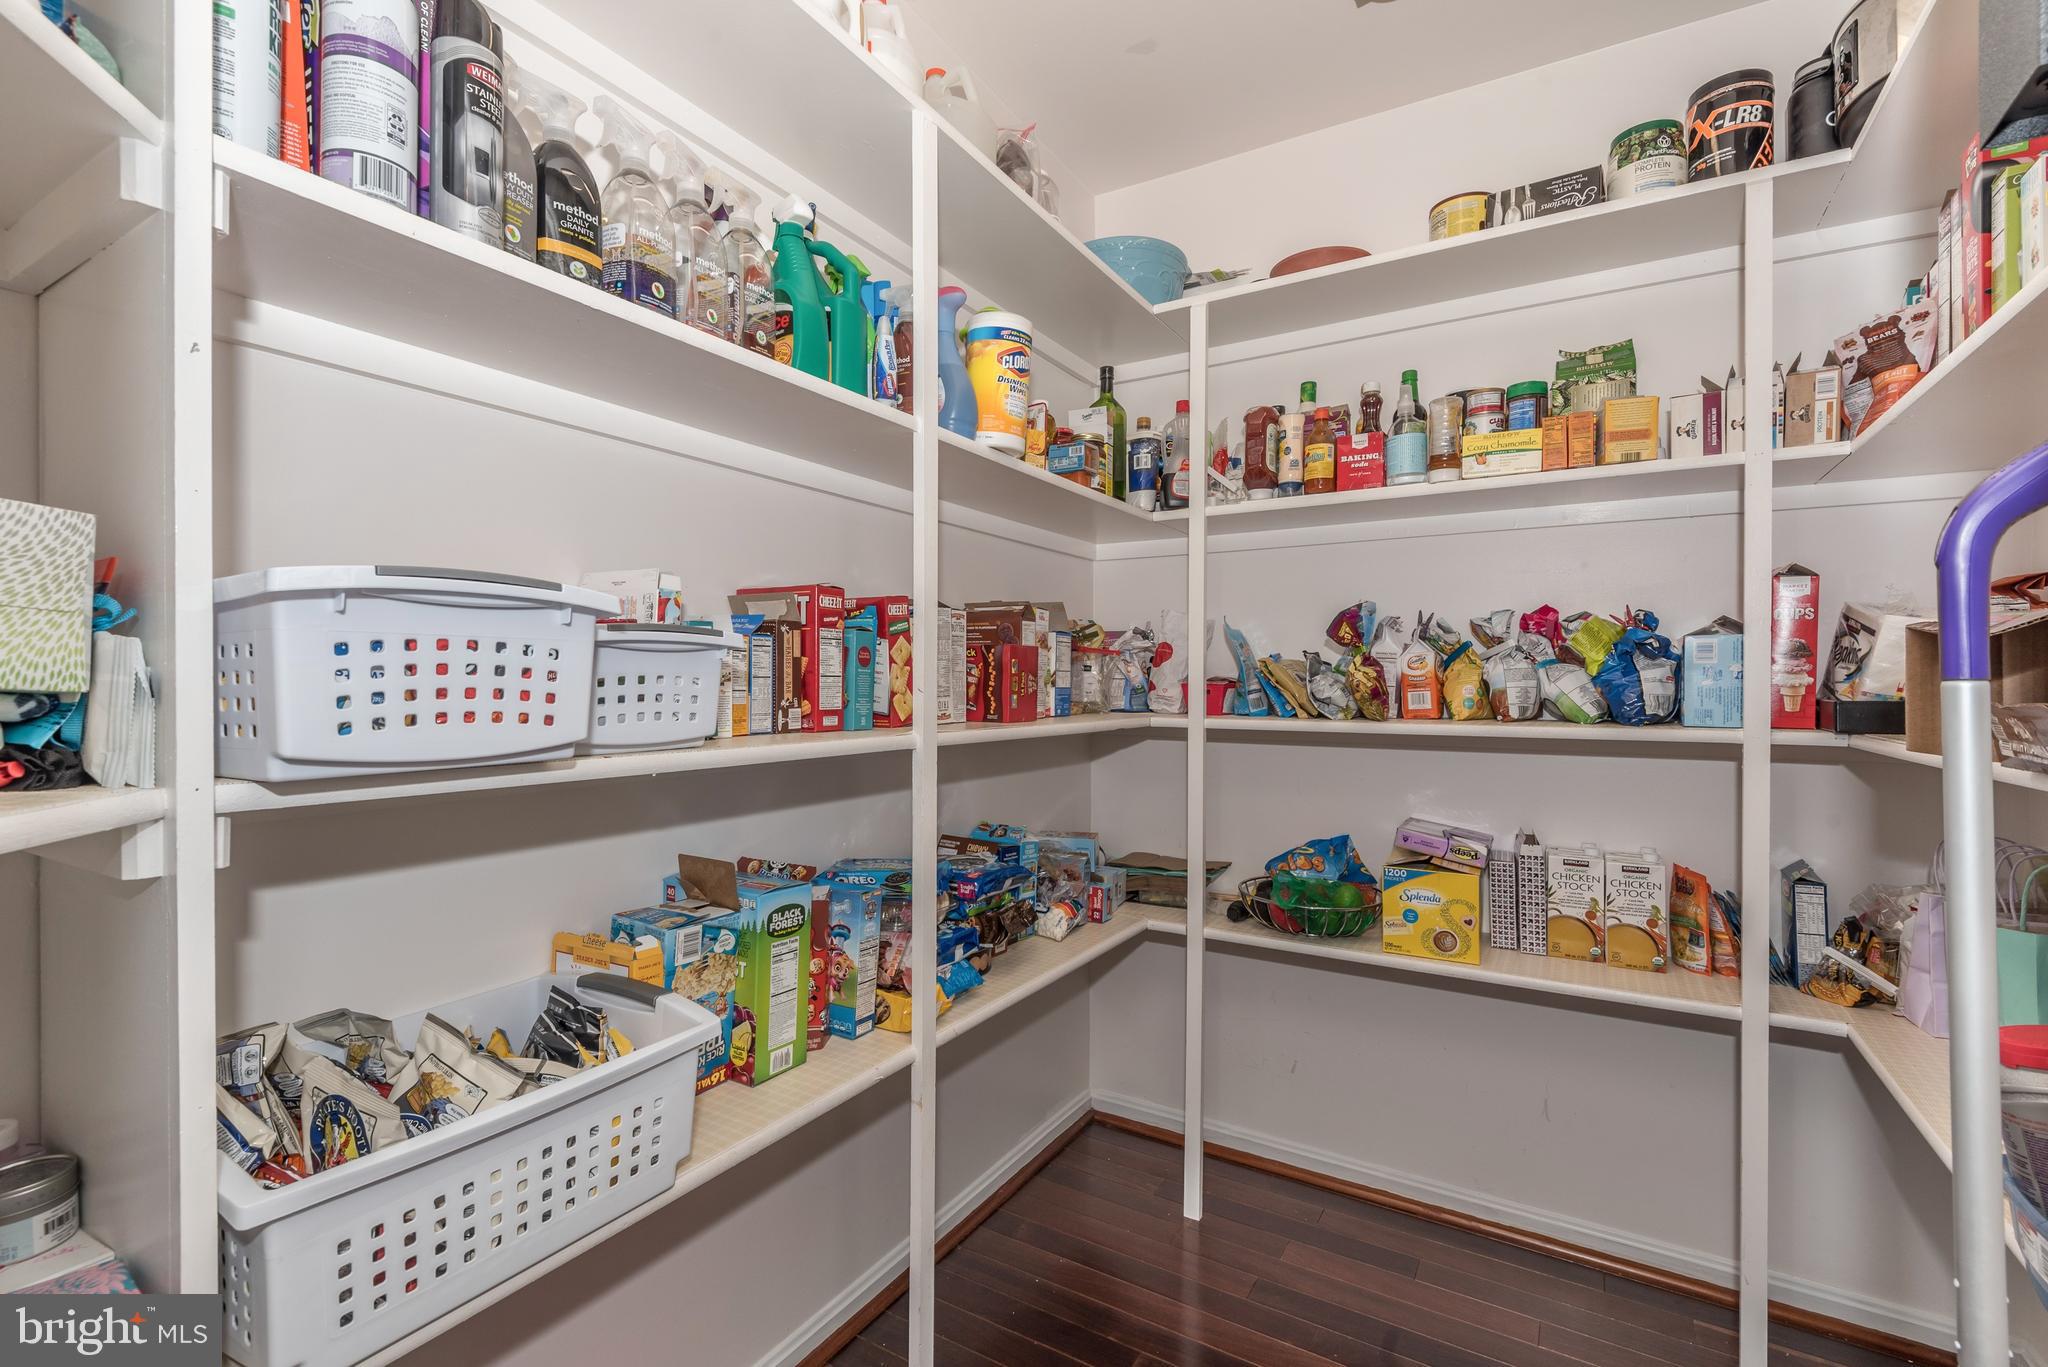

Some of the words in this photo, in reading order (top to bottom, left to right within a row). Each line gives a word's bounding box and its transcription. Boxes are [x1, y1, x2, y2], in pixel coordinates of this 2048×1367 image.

[420, 1, 429, 17] OF
[420, 17, 429, 54] CLEAN!
[471, 64, 503, 91] WEIM
[466, 83, 503, 110] STAINLE
[1646, 148, 1680, 156] PlantFusion
[1635, 157, 1665, 167] COMPLETE
[1635, 161, 1671, 174] PROTEIN
[504, 170, 534, 195] thod
[1552, 183, 1581, 195] PLASTIC
[506, 189, 534, 210] REASER
[1540, 186, 1598, 210] Reflections
[553, 200, 599, 226] method
[566, 213, 590, 229] DAILY
[560, 220, 595, 239] GRANITE
[638, 227, 673, 250] method
[695, 256, 726, 276] method
[746, 282, 775, 301] method
[1867, 327, 1899, 345] BEARS
[1002, 354, 1031, 370] CLORO
[1576, 360, 1613, 372] BIGELOW
[997, 375, 1030, 391] DISINFECT
[1009, 384, 1027, 397] WIPE
[1690, 419, 1698, 440] QUAKER
[1467, 443, 1489, 454] Cozy
[1490, 436, 1537, 450] Chamomile
[1341, 452, 1380, 463] BAKING
[1350, 461, 1369, 469] soda
[819, 595, 843, 609] CHEEZ-IT
[887, 603, 908, 616] CHEEZ-IT
[1449, 847, 1481, 861] Peeps
[834, 876, 876, 885] OREO
[1384, 868, 1407, 878] 1200
[1551, 871, 1601, 884] CHICKEN
[666, 887, 675, 896] 40
[1557, 881, 1595, 893] STOCK
[1610, 879, 1662, 891] CHICKEN
[1400, 888, 1442, 903] Splenda
[1616, 889, 1656, 900] STOCK
[772, 907, 802, 923] BLACK
[769, 916, 804, 932] FOREST
[582, 935, 607, 948] Cheese
[576, 954, 594, 963] TRADER
[594, 958, 608, 967] JOE'S
[706, 1043, 726, 1062] RICE
[711, 1068, 727, 1085] 16
[315, 1099, 345, 1128] PIRATE'S
[346, 1106, 368, 1154] BOOTY
